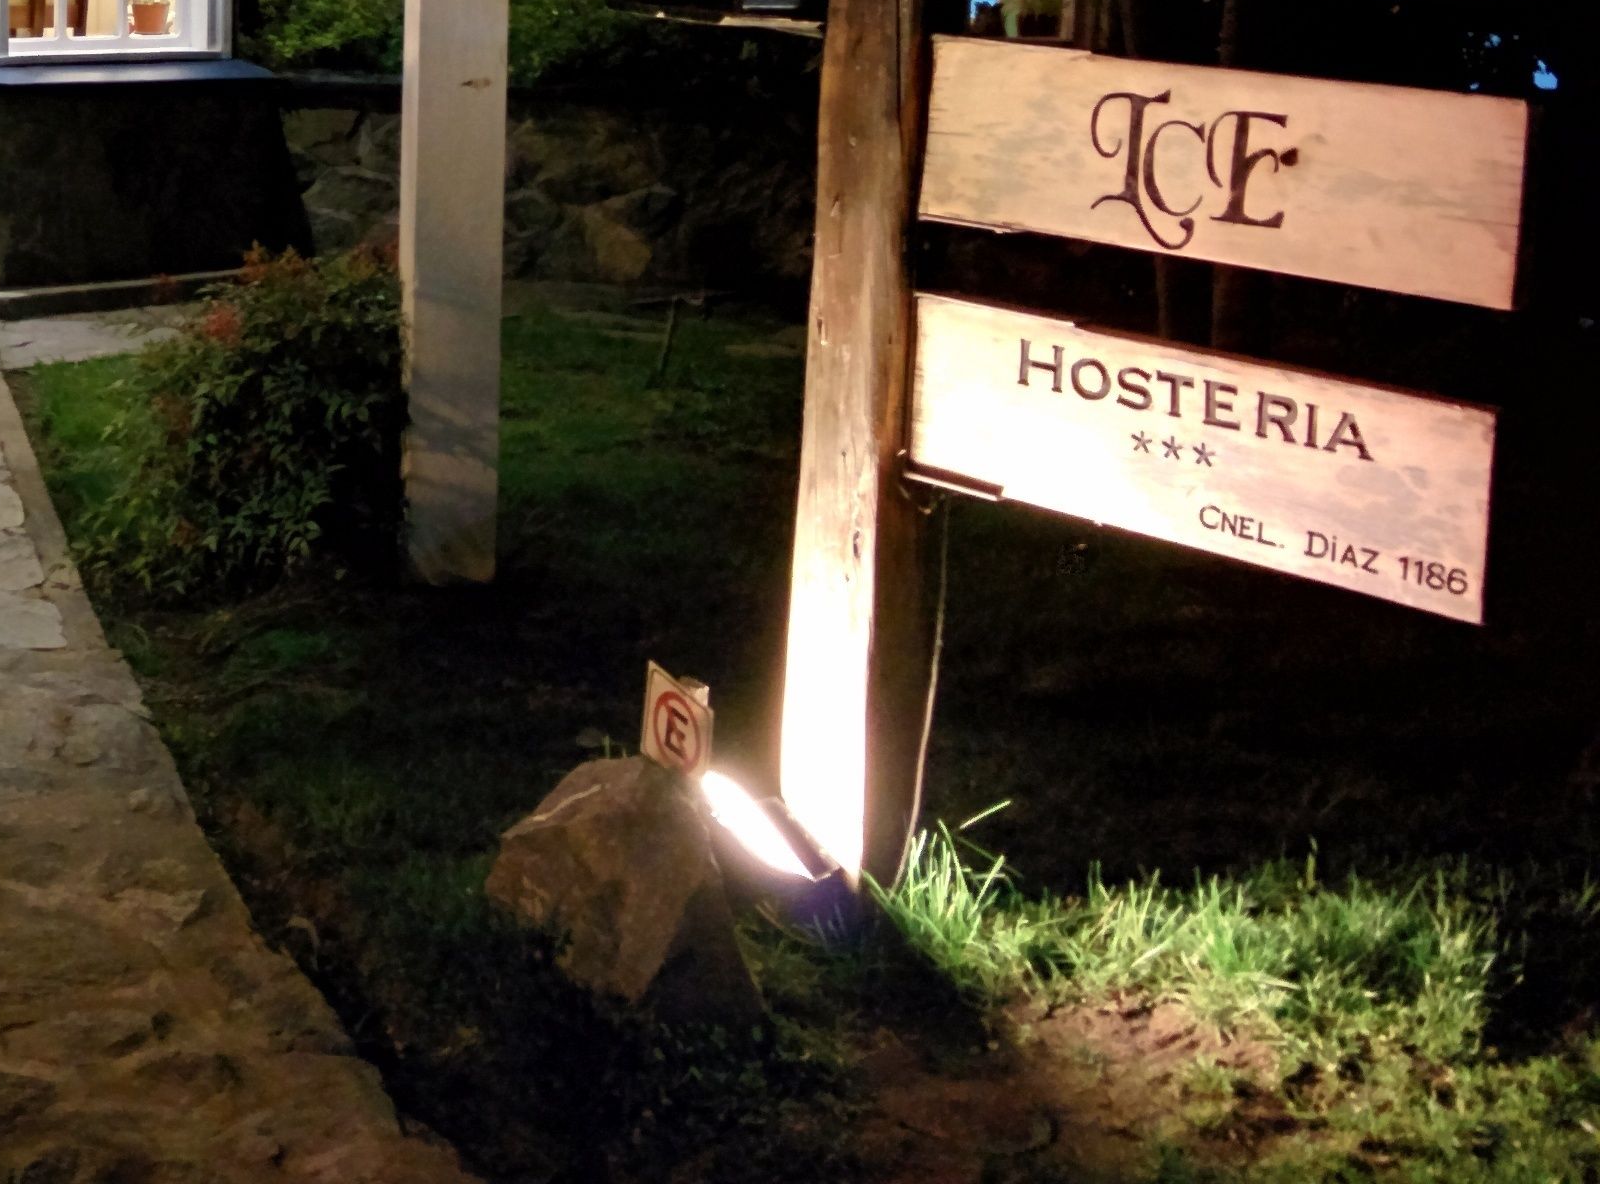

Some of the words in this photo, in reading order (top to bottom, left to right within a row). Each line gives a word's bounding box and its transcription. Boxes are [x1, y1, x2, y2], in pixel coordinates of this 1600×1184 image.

[1015, 337, 1374, 462] HOSTERIA
[1198, 504, 1285, 549] CNEL.
[1397, 555, 1468, 596] 1186
[664, 706, 689, 759] E
